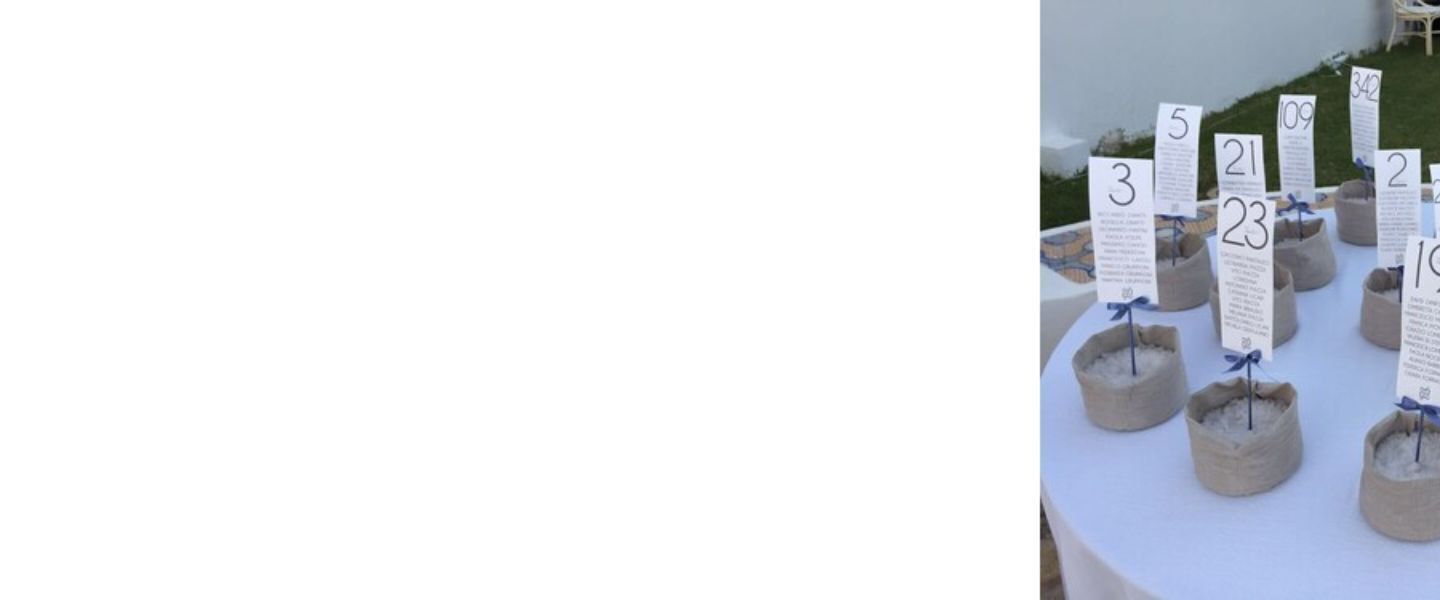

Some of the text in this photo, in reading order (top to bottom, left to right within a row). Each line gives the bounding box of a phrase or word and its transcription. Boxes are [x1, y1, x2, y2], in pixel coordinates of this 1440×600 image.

[1351, 71, 1380, 103] 342
[1168, 107, 1189, 140] 5
[1279, 100, 1315, 130] 109
[1223, 138, 1256, 176] 21
[1387, 152, 1408, 187] 2
[1108, 162, 1136, 206] 3
[1221, 196, 1269, 250] 23
